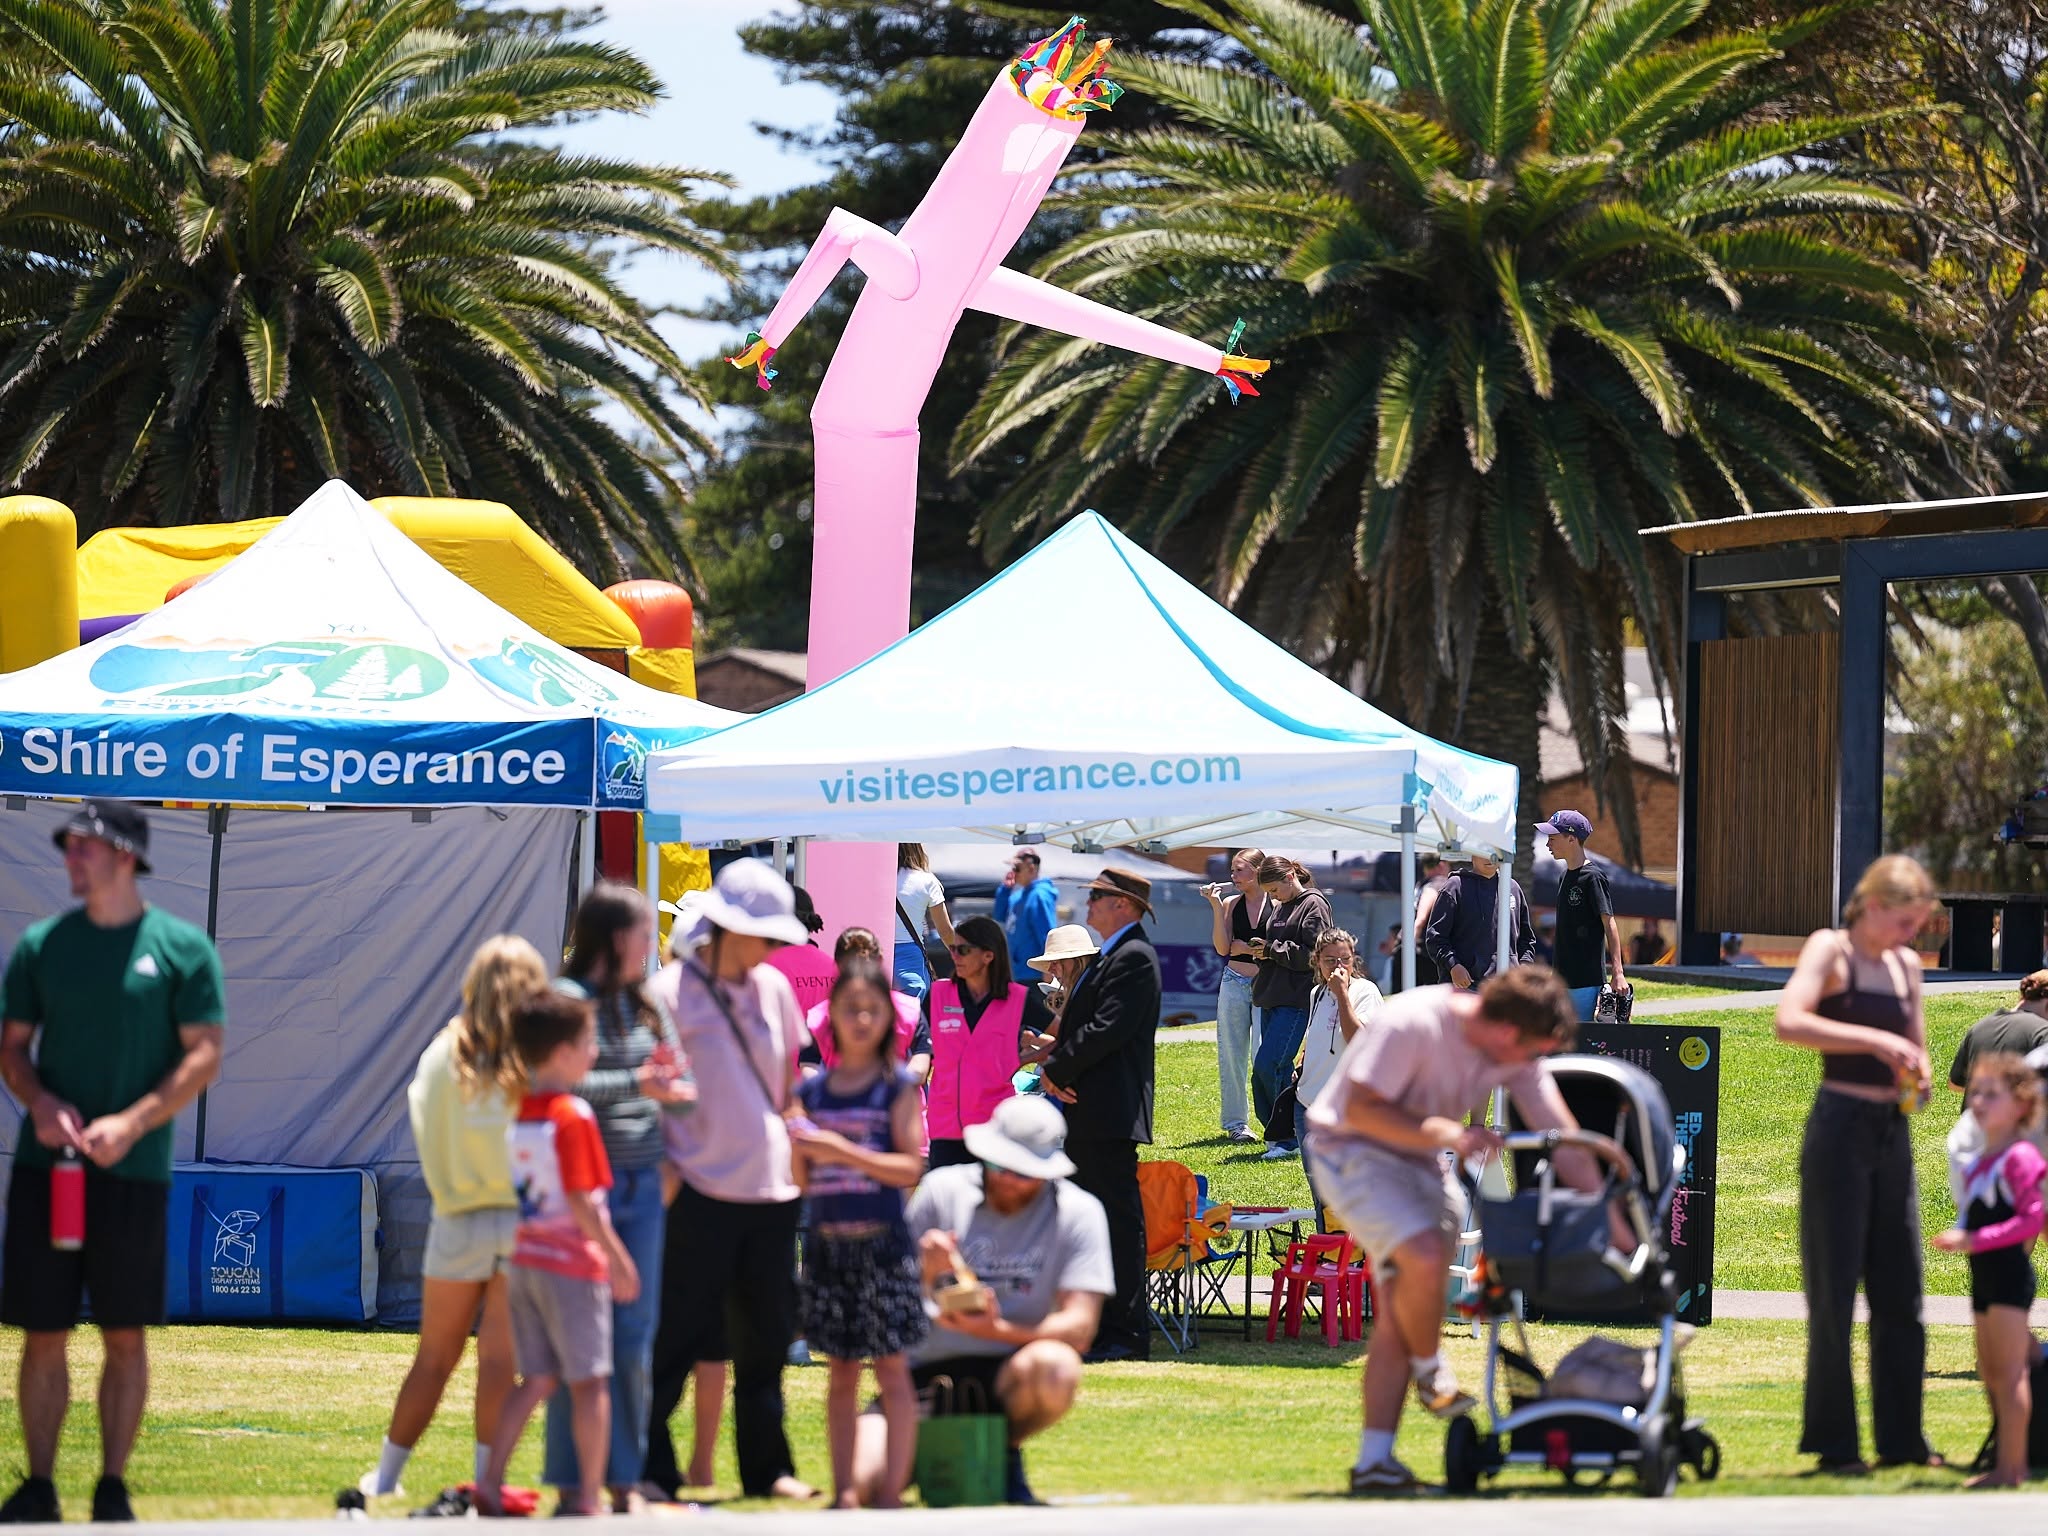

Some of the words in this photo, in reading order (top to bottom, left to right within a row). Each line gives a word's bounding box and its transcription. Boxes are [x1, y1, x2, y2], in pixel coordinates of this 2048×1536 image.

[21, 727, 167, 778] Shire
[186, 733, 244, 779] of
[262, 734, 566, 794] Esperance
[819, 755, 1241, 805] visitesperance.com
[211, 1266, 260, 1278] TOUCAN
[212, 1286, 229, 1294] 1800
[230, 1286, 240, 1294] 64
[240, 1286, 250, 1294] 22
[251, 1286, 261, 1294] 33
